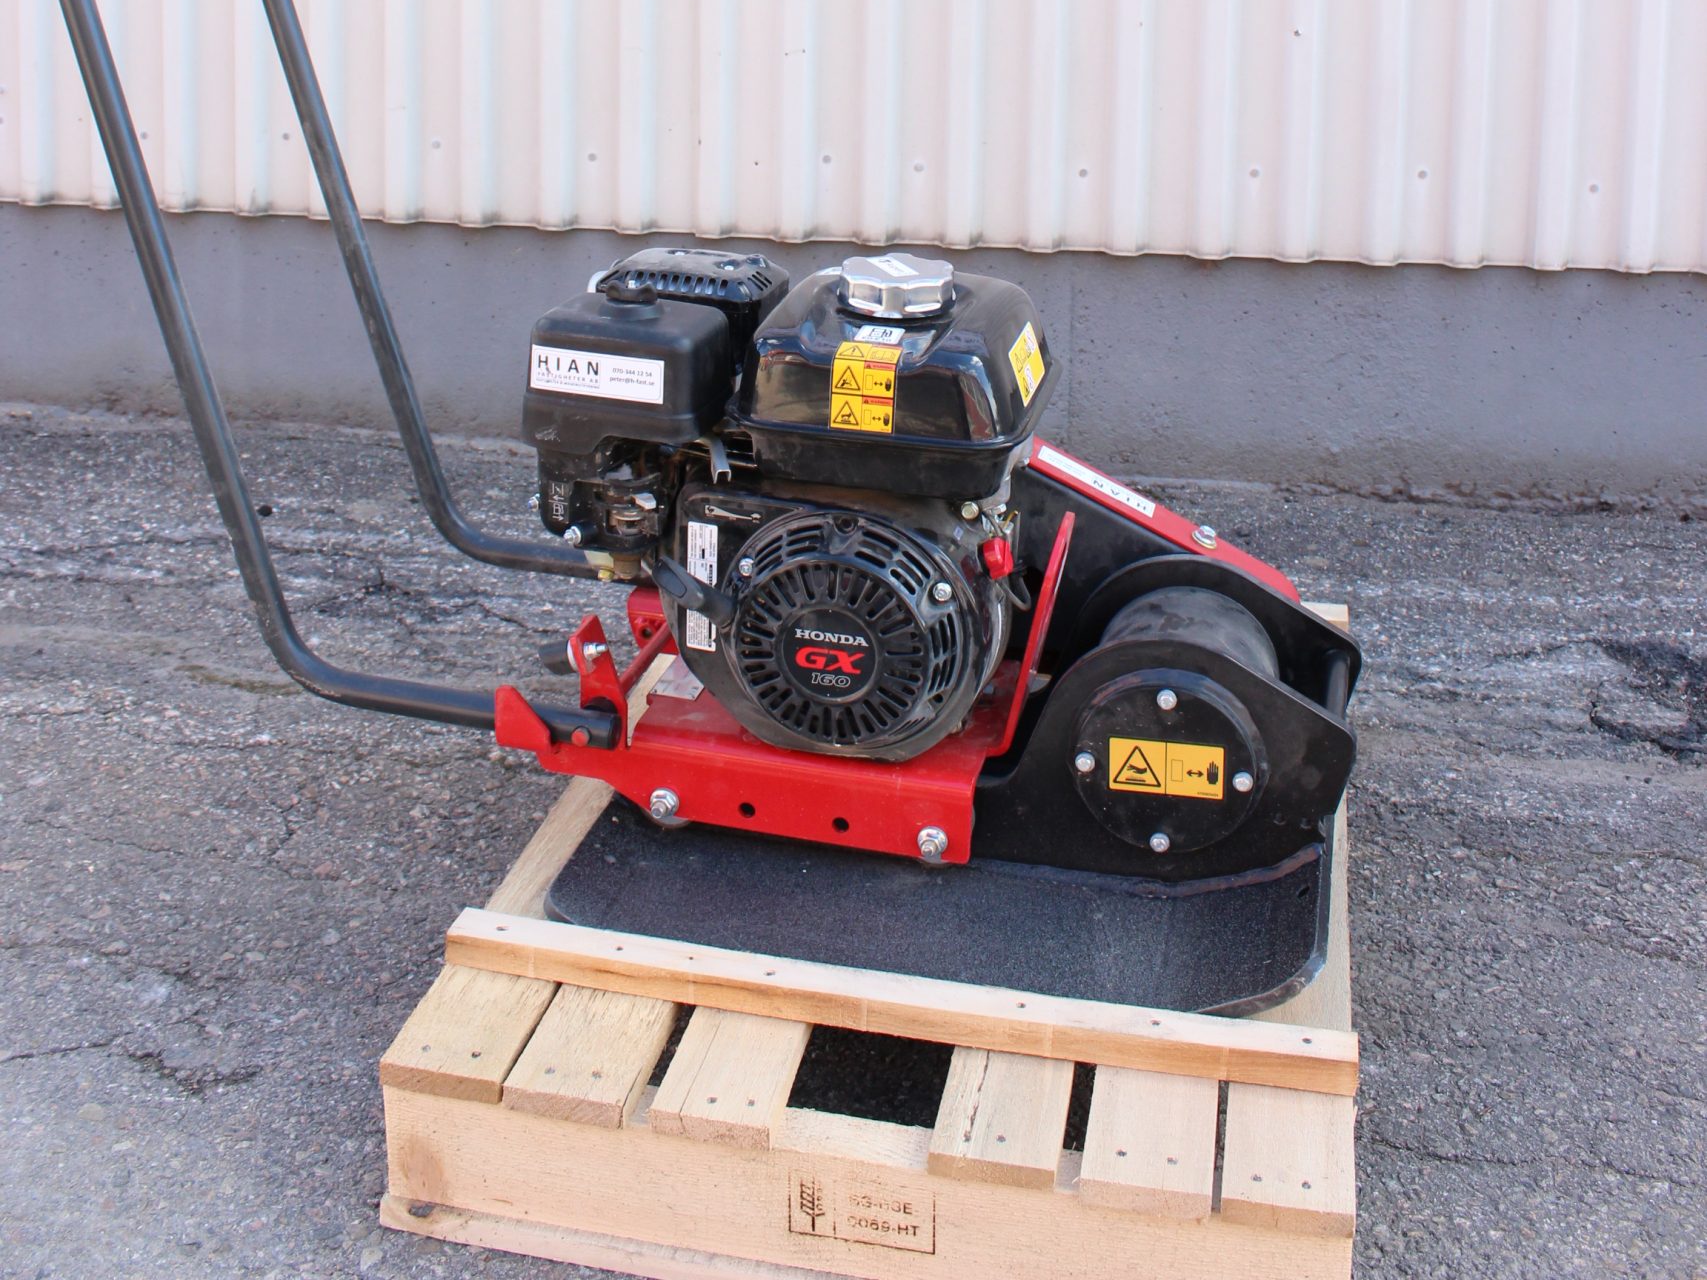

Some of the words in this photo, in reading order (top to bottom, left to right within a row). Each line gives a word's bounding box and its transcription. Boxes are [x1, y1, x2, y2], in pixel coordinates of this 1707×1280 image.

[538, 354, 600, 376] HIAN
[795, 628, 869, 647] HONDA
[795, 645, 865, 674] GX
[811, 672, 851, 687] 160
